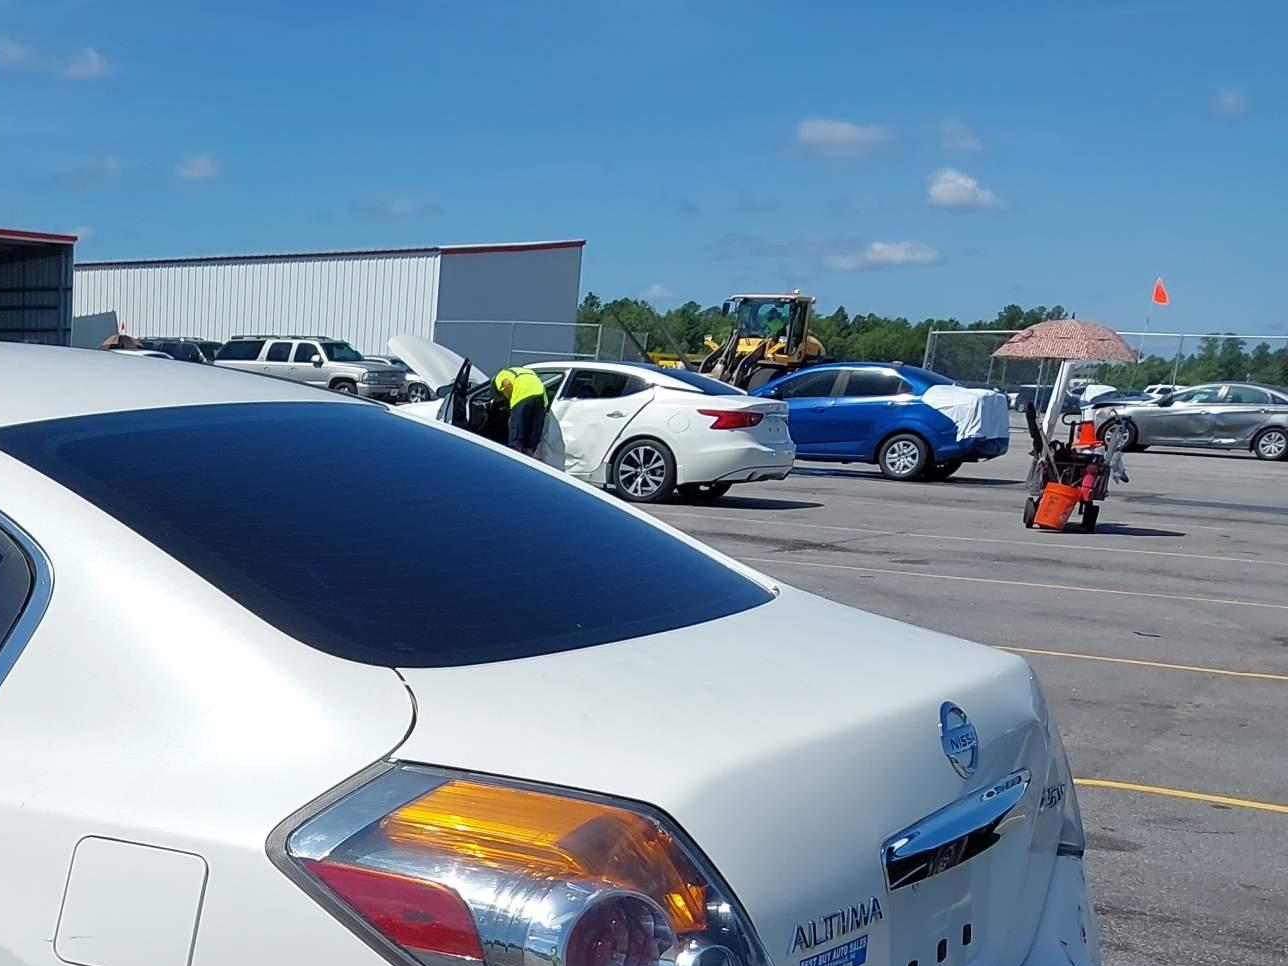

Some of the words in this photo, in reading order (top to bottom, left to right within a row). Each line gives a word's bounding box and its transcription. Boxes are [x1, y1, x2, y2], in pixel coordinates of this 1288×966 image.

[789, 896, 884, 954] ALTIMA
[818, 952, 832, 965] BUY
[831, 944, 849, 959] AUTO
[848, 937, 867, 953] SALES
